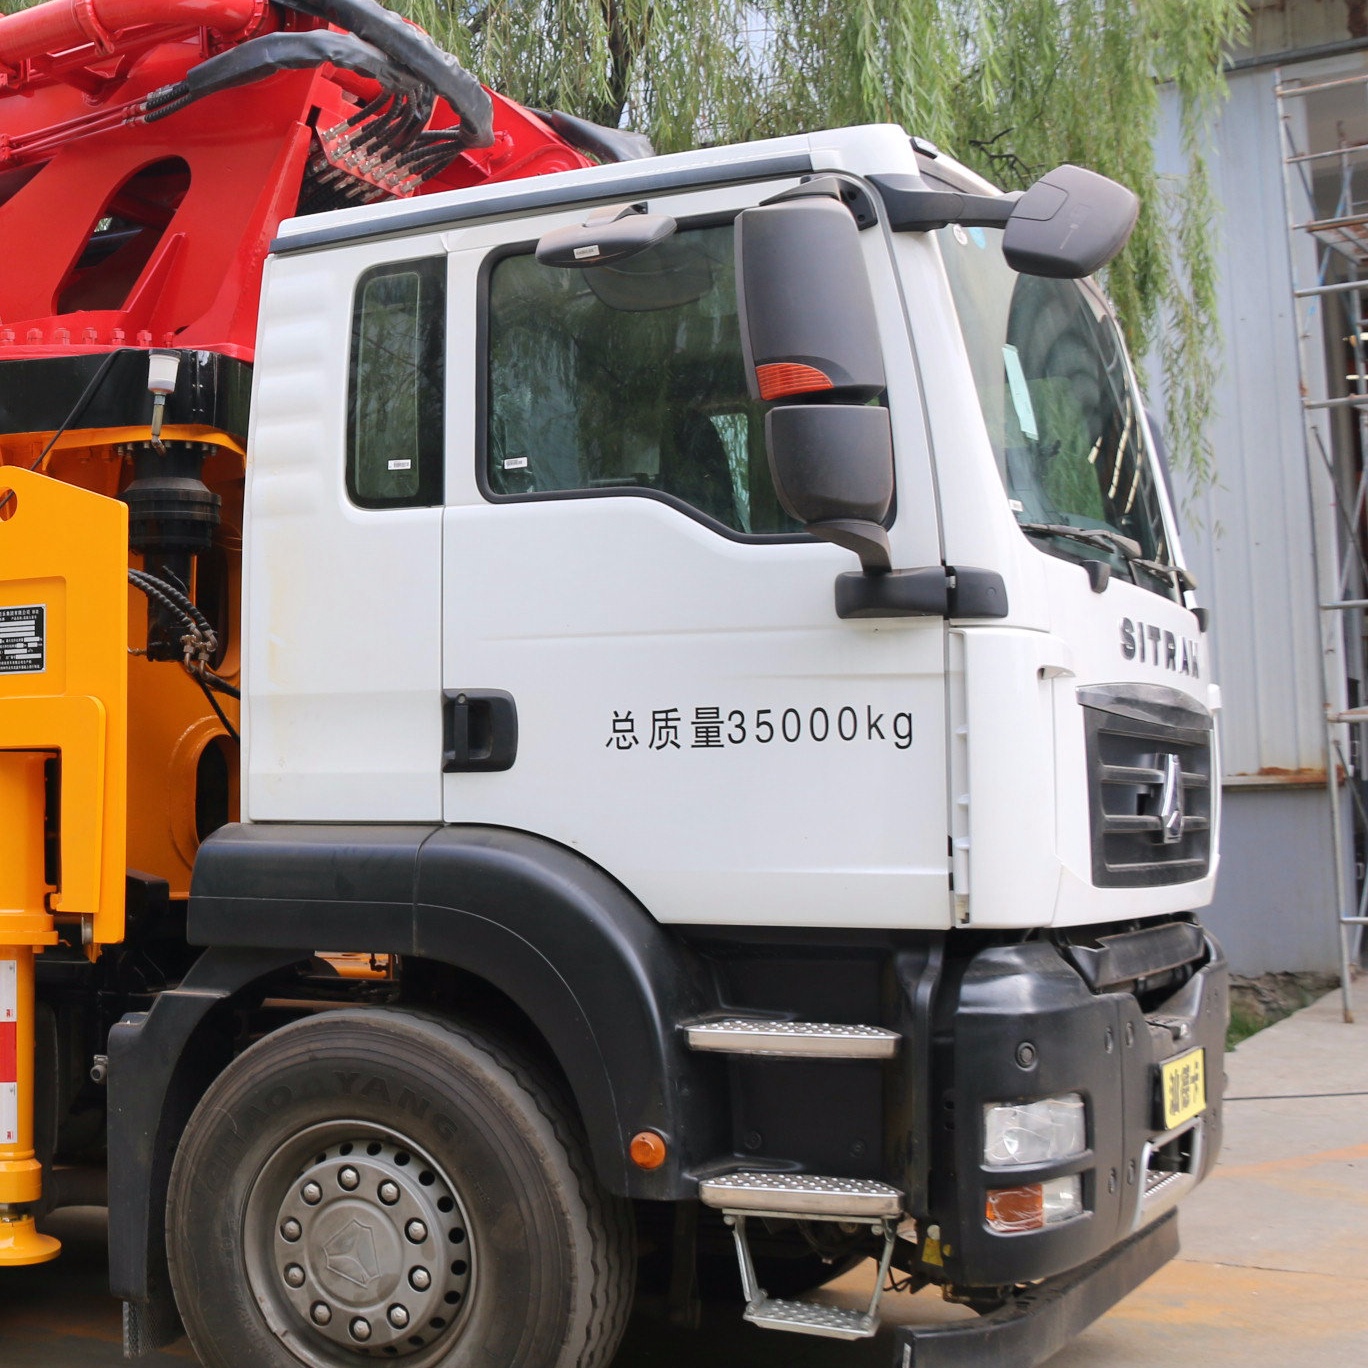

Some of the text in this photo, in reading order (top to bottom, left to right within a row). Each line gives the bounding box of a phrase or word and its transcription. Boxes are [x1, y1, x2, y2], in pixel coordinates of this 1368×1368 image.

[605, 705, 913, 750] 总质量35000kg
[334, 1069, 460, 1142] YANG
